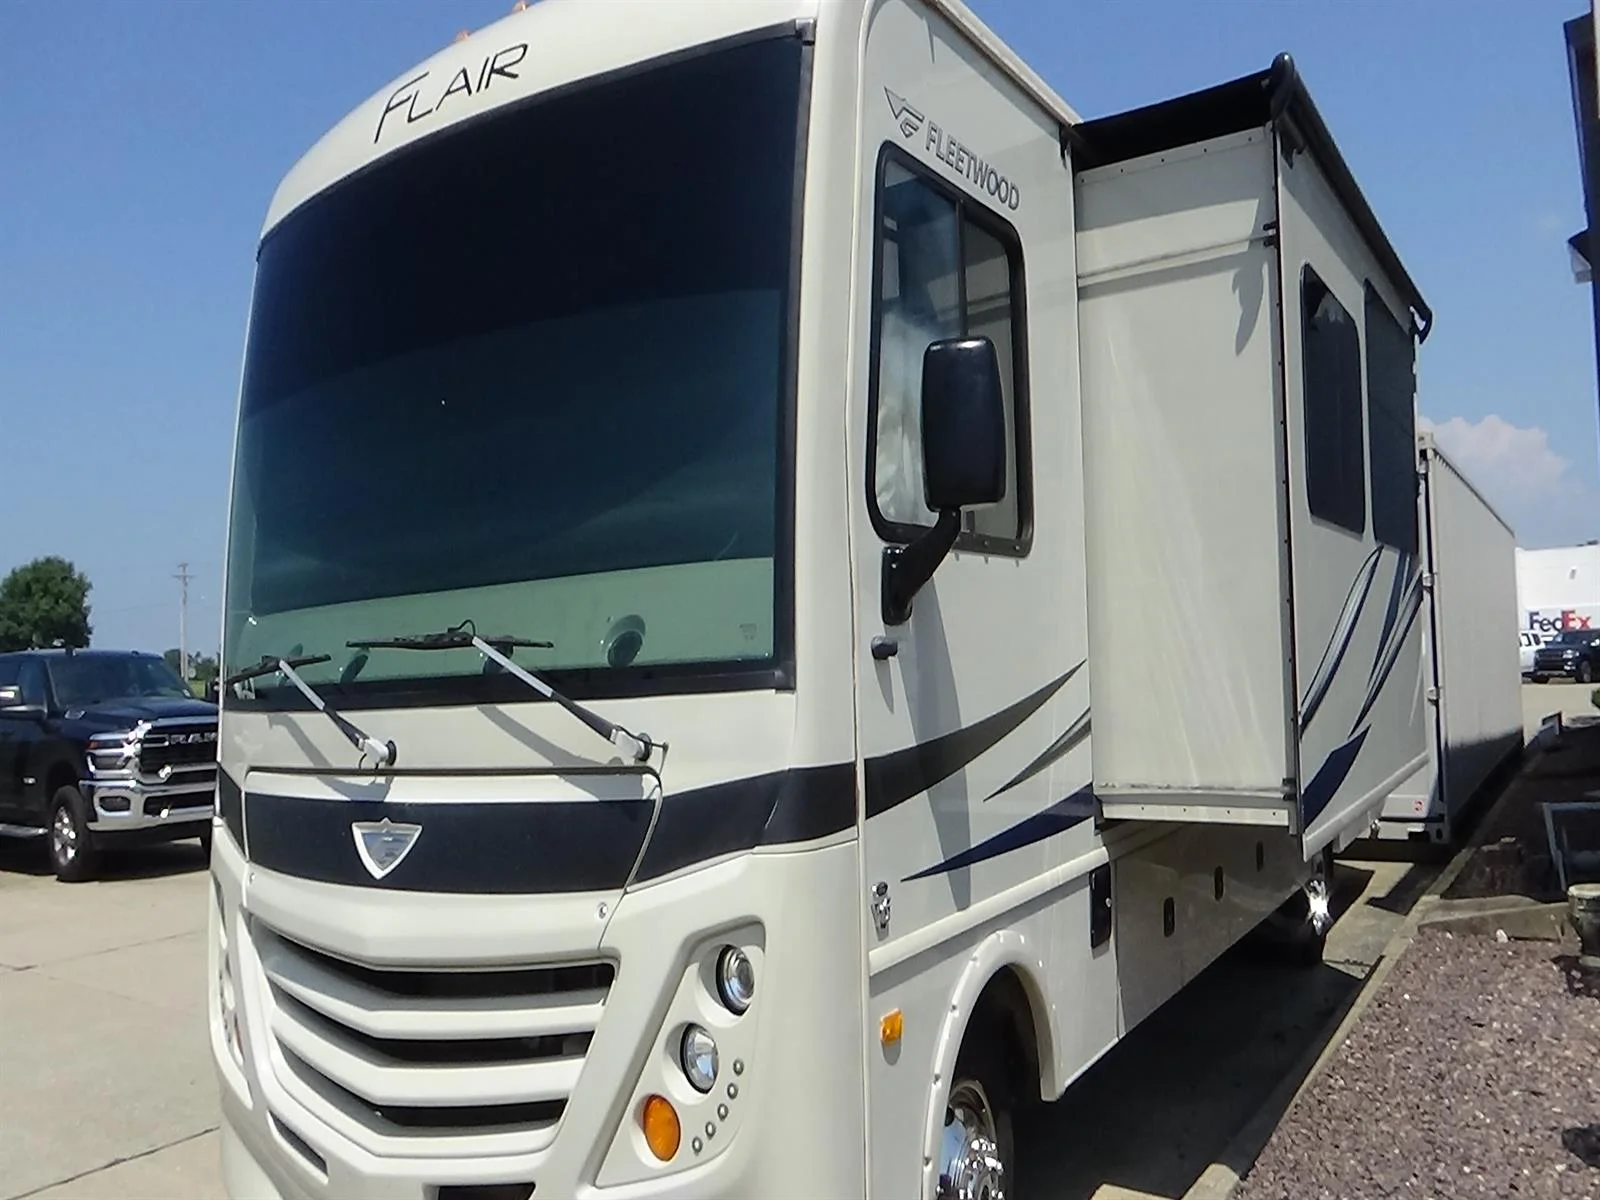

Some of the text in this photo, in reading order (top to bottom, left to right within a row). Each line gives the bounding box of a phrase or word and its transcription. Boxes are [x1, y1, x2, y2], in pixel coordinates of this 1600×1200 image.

[374, 43, 528, 143] FLAIR
[926, 120, 1020, 211] FLEETWOOD
[1528, 609, 1592, 632] FedEx
